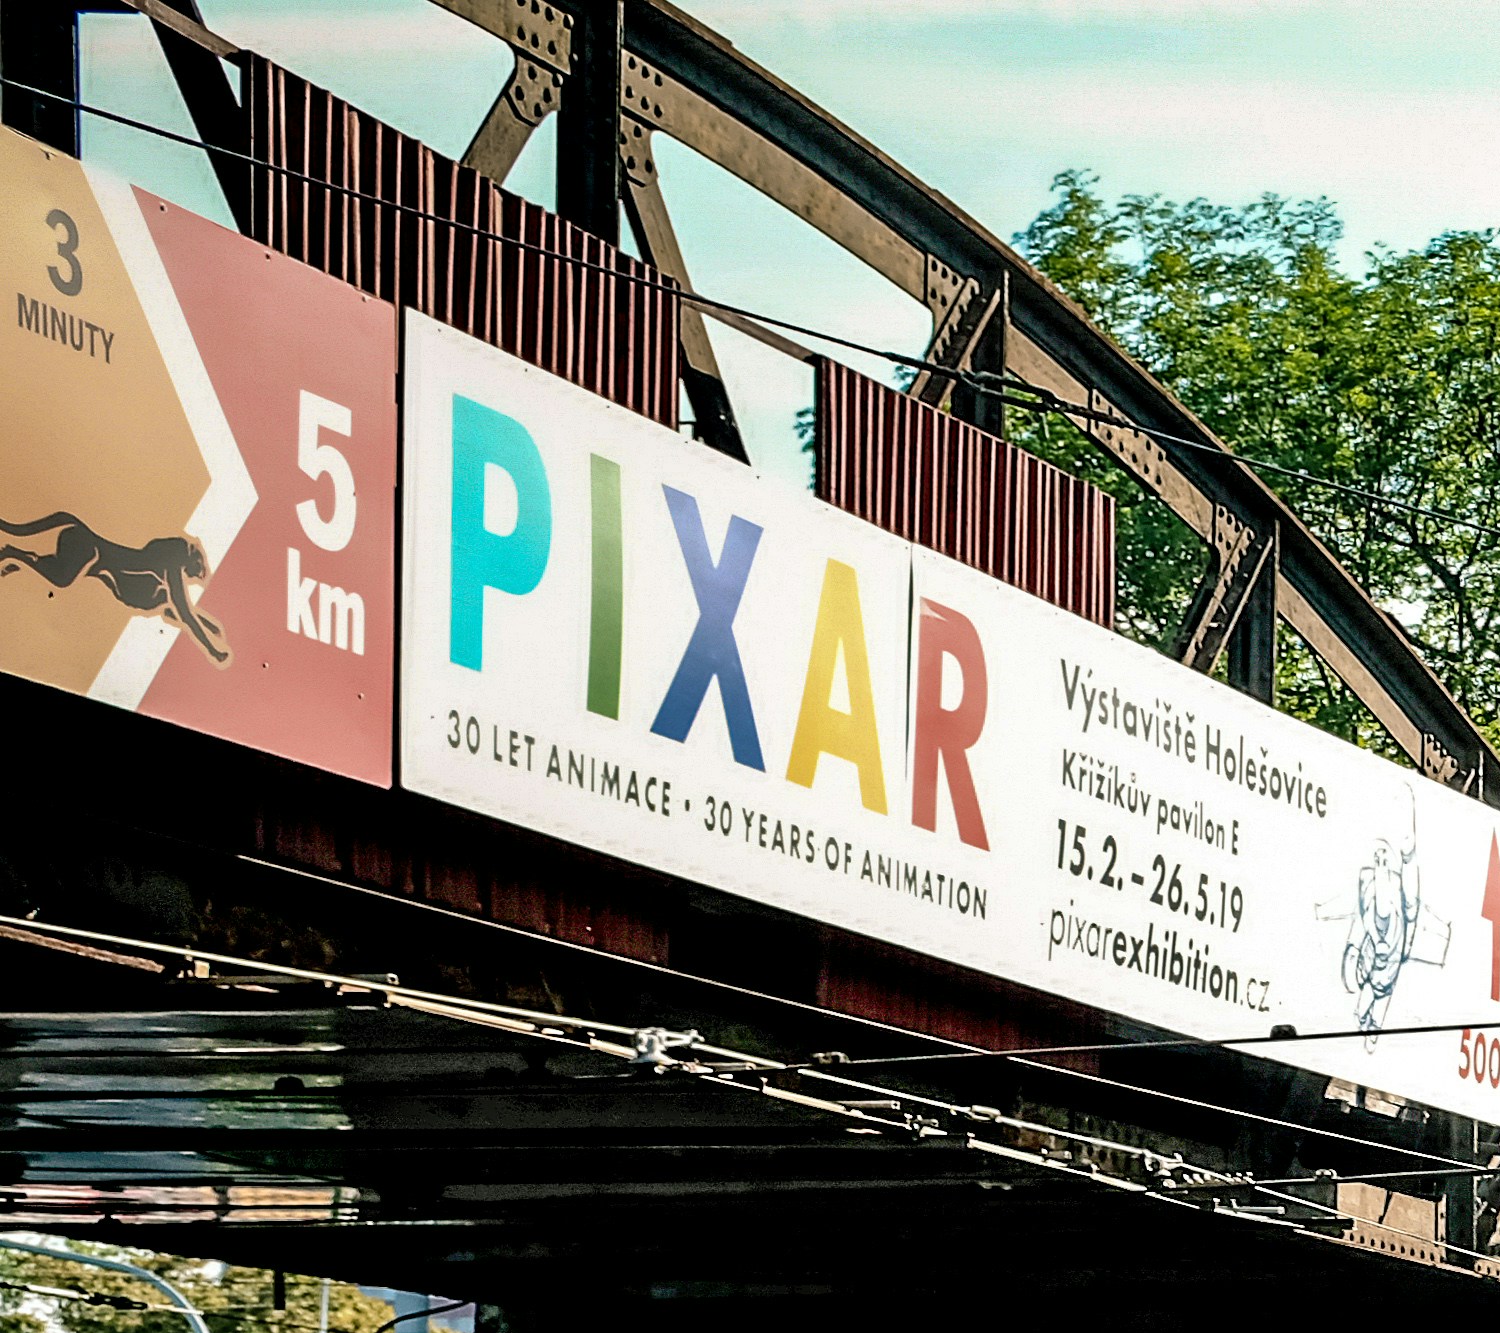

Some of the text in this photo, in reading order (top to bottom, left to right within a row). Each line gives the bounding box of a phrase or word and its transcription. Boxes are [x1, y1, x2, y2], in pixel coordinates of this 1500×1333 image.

[45, 209, 83, 297] 3
[15, 293, 115, 365] MINUTY
[295, 389, 358, 553] 5
[287, 548, 366, 656] km
[449, 392, 990, 852] PIXAR
[1061, 658, 1327, 818] Výstaviště Holešovice
[447, 710, 480, 755] 30
[494, 725, 535, 771] LET
[547, 745, 670, 817] ANIMACE
[704, 796, 732, 836] 30
[742, 807, 815, 863] YEARS
[825, 836, 852, 874] OF
[860, 850, 987, 920] ANIMATION
[1062, 749, 1239, 856] Křižíkův pavilon E
[1048, 899, 1271, 1012] pixarexhibition.cz
